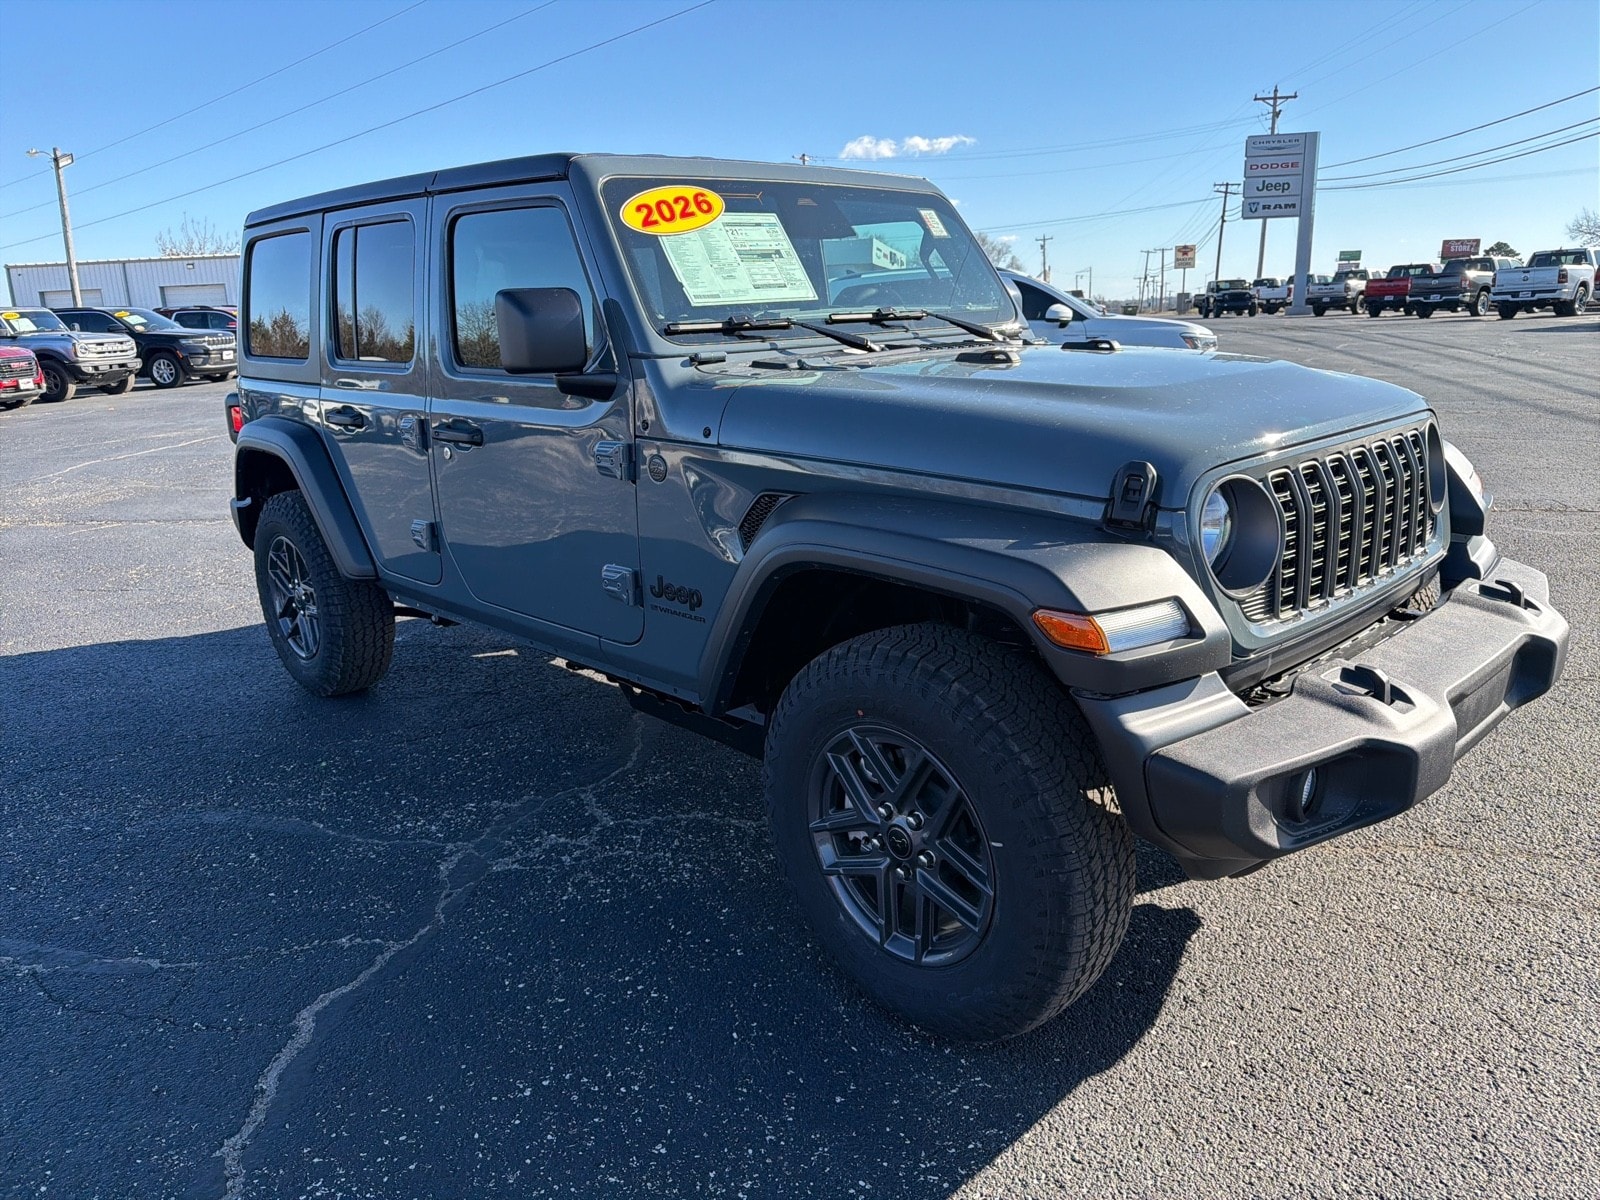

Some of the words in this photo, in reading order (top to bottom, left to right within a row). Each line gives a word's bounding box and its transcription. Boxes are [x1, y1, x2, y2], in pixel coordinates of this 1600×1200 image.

[1252, 138, 1300, 146] CHRYSLER
[1249, 161, 1300, 171] DODGE
[1256, 180, 1291, 193] Jeep
[635, 192, 714, 229] 2026
[1262, 202, 1297, 211] RAM
[650, 574, 703, 611] Jeep
[658, 605, 706, 623] WRANGLER
